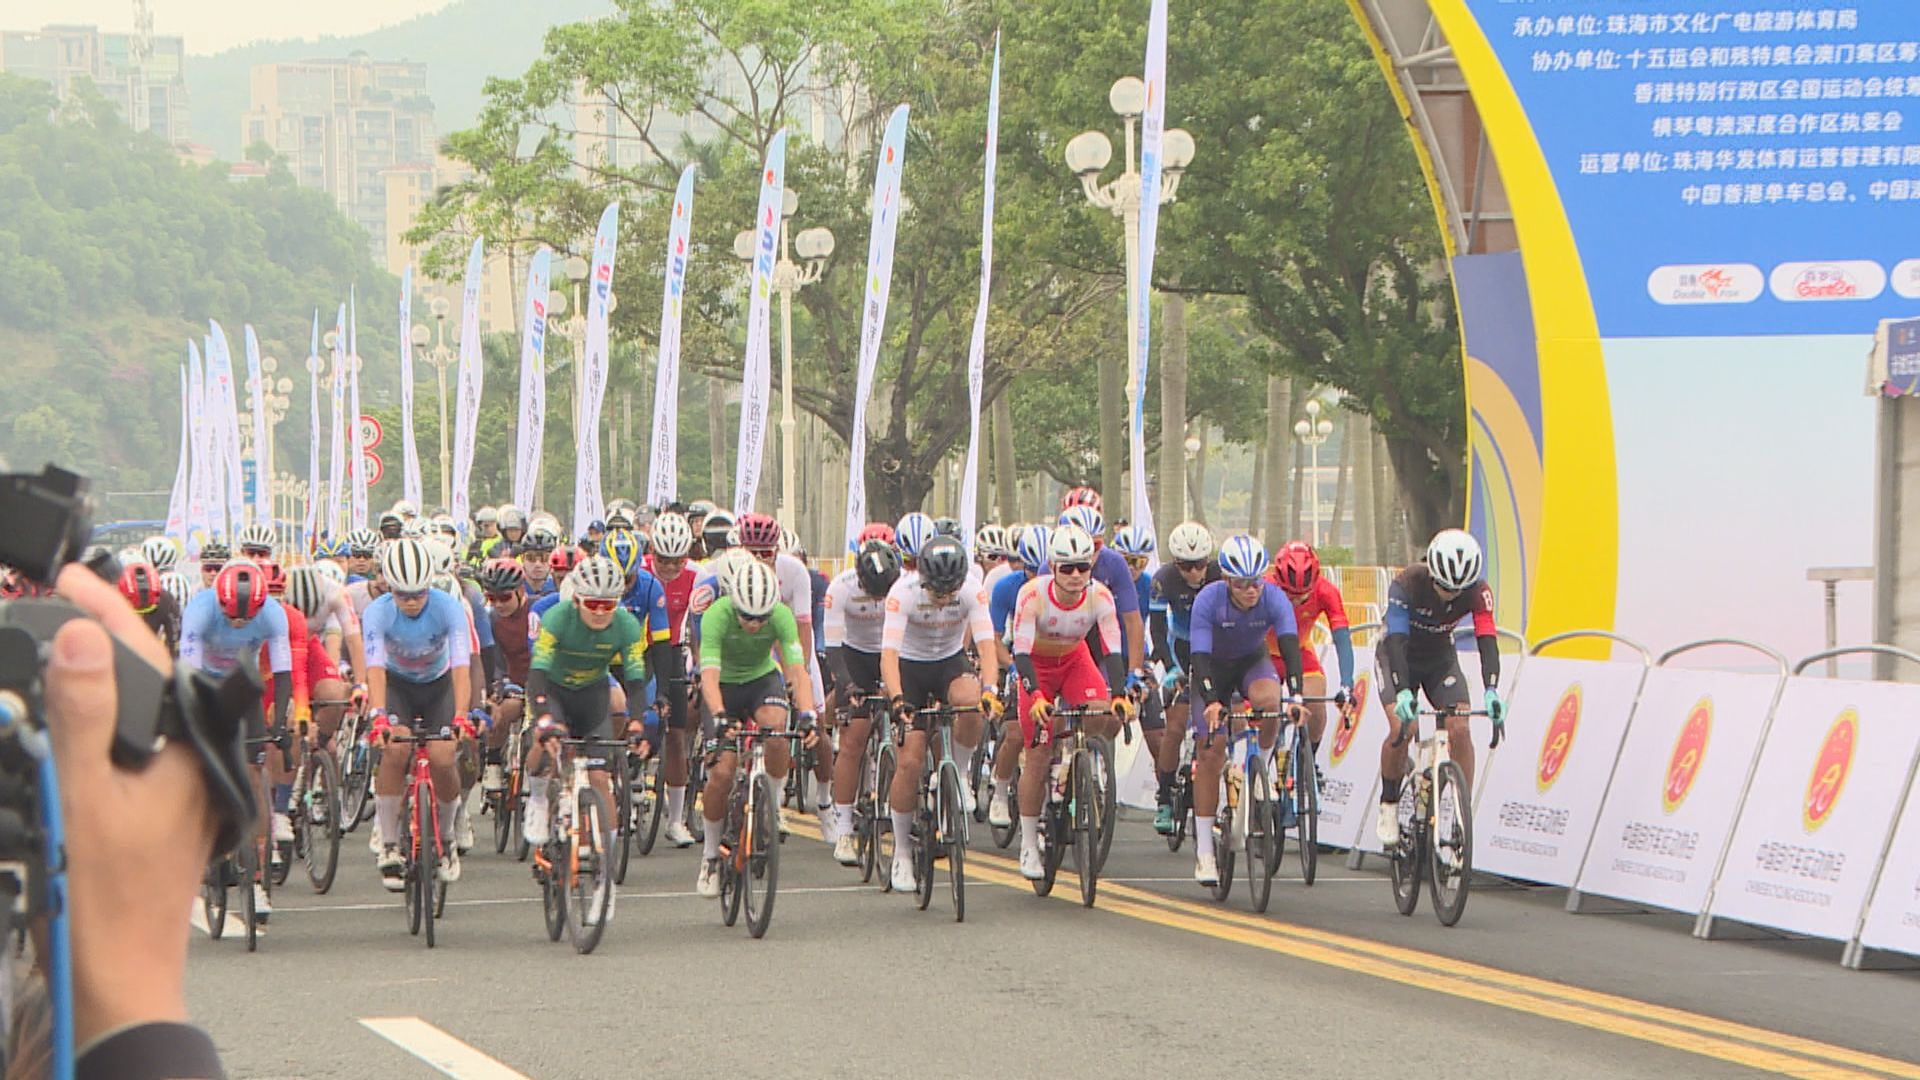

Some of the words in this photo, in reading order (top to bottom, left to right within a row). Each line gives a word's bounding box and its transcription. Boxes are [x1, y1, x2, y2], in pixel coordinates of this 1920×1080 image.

[1531, 42, 1920, 72] 协办单位：十五运会和残特奥会澳门赛区筹
